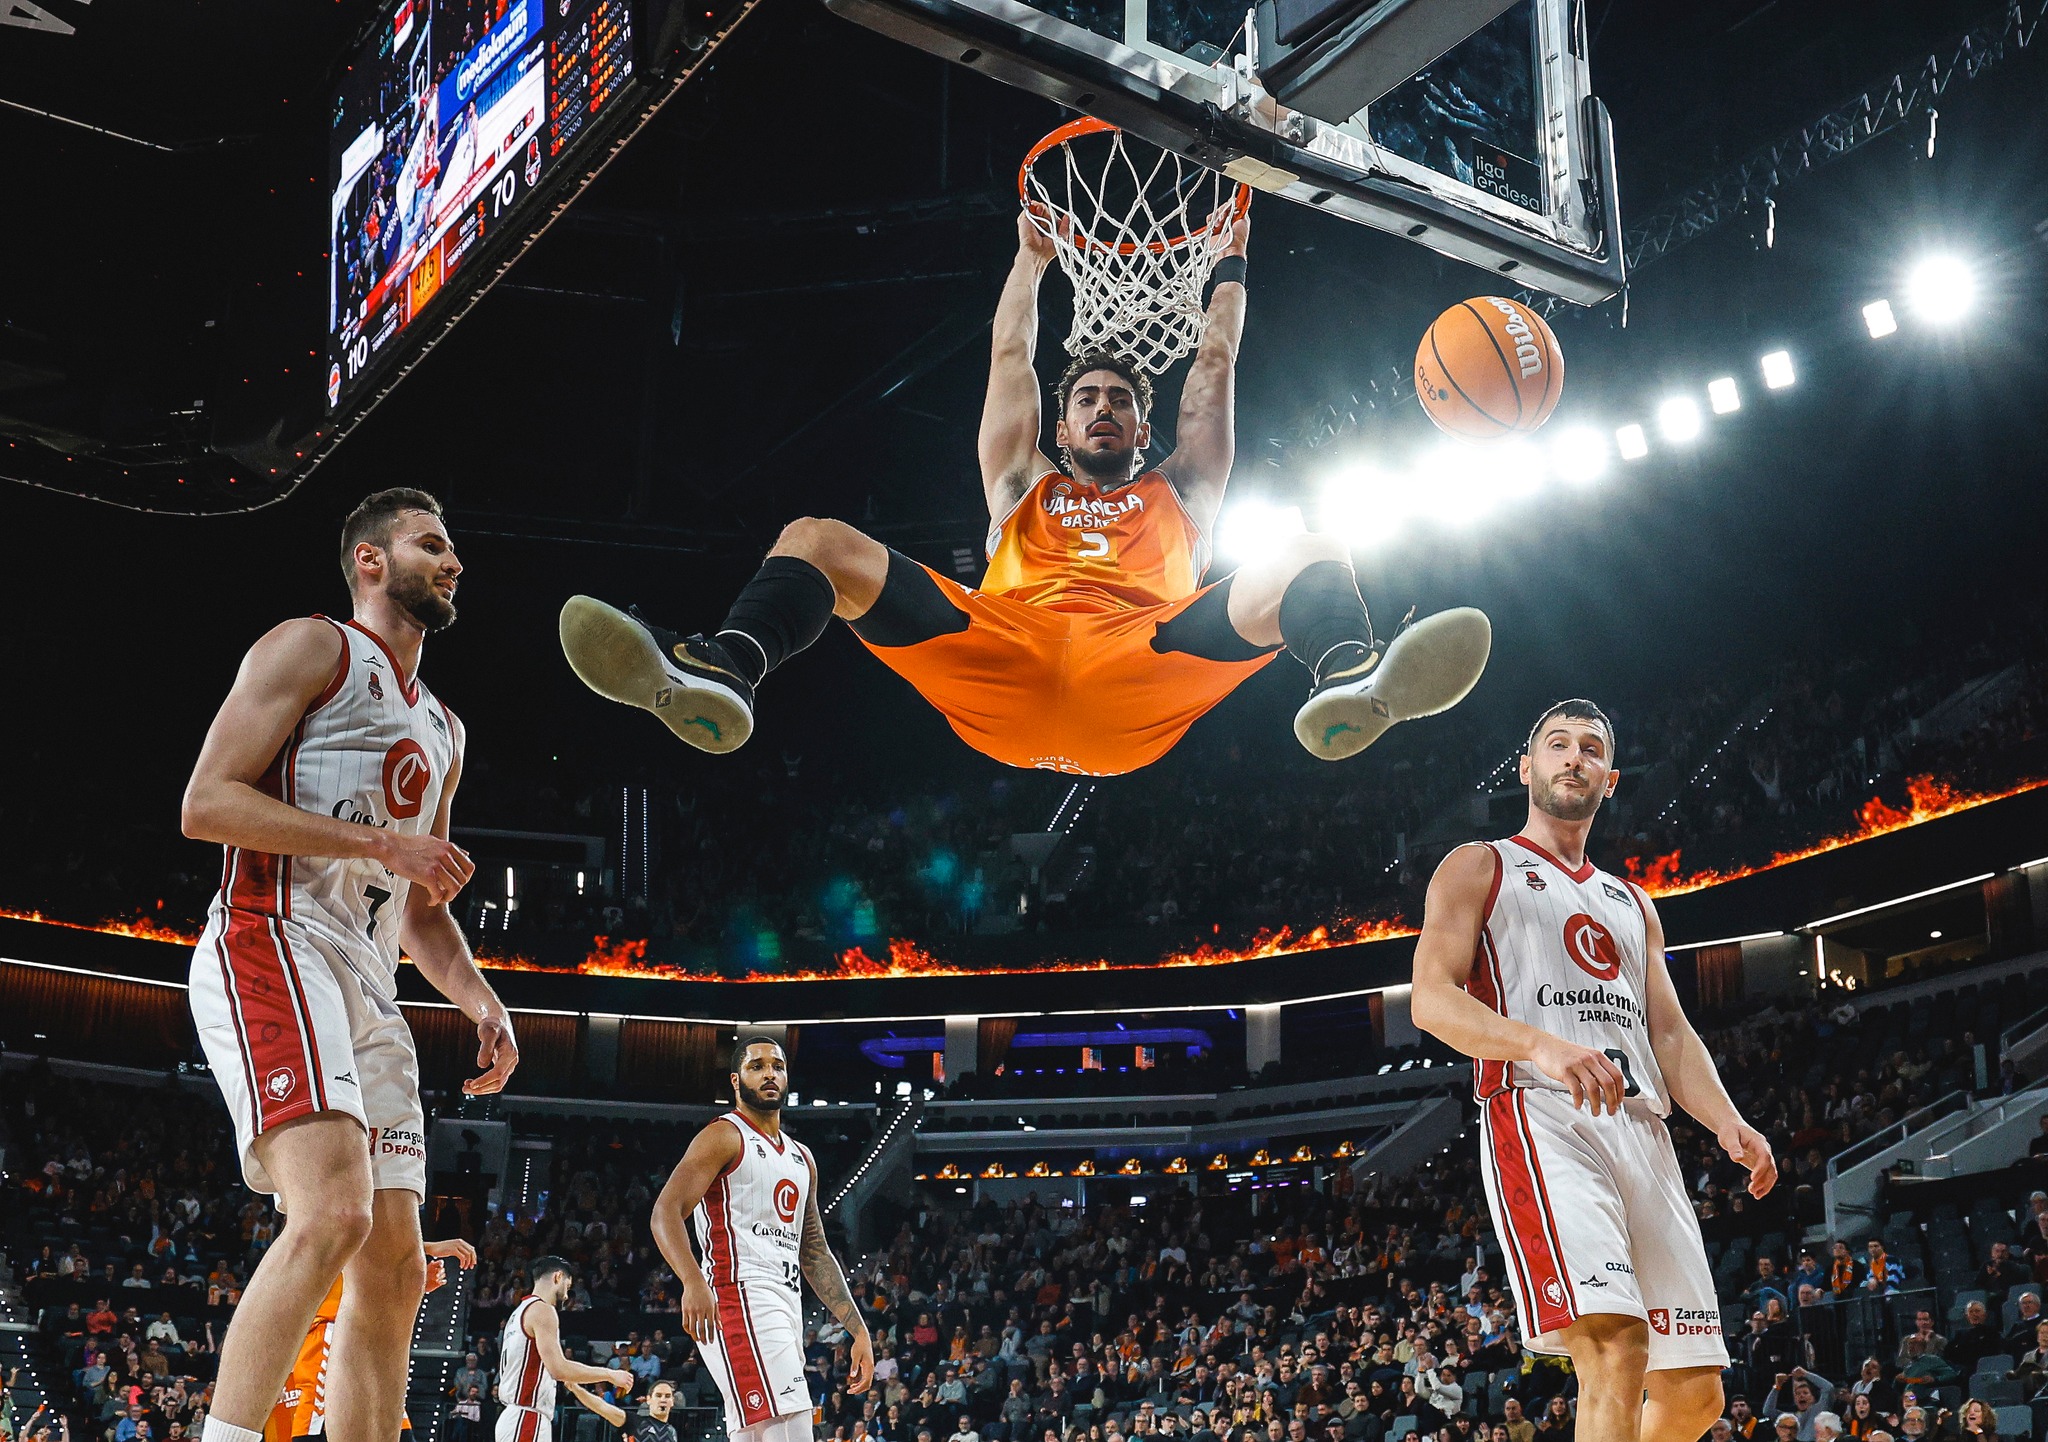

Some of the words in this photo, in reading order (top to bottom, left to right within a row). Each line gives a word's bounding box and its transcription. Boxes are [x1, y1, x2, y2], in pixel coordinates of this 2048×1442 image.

[459, 9, 528, 91] mediolanum
[622, 25, 631, 42] 11
[582, 73, 588, 88] 9
[623, 60, 632, 77] 19
[1475, 154, 1505, 180] liga
[477, 200, 485, 218] 5
[491, 169, 516, 218] 70
[1477, 176, 1540, 212] endesa
[477, 220, 485, 237] 3
[415, 253, 435, 292] 47.5
[1486, 297, 1543, 379] Wilson
[347, 335, 369, 379] 110
[1418, 364, 1438, 401] acb
[362, 883, 392, 941] 7
[1577, 1009, 1633, 1031] ZARAGOZA
